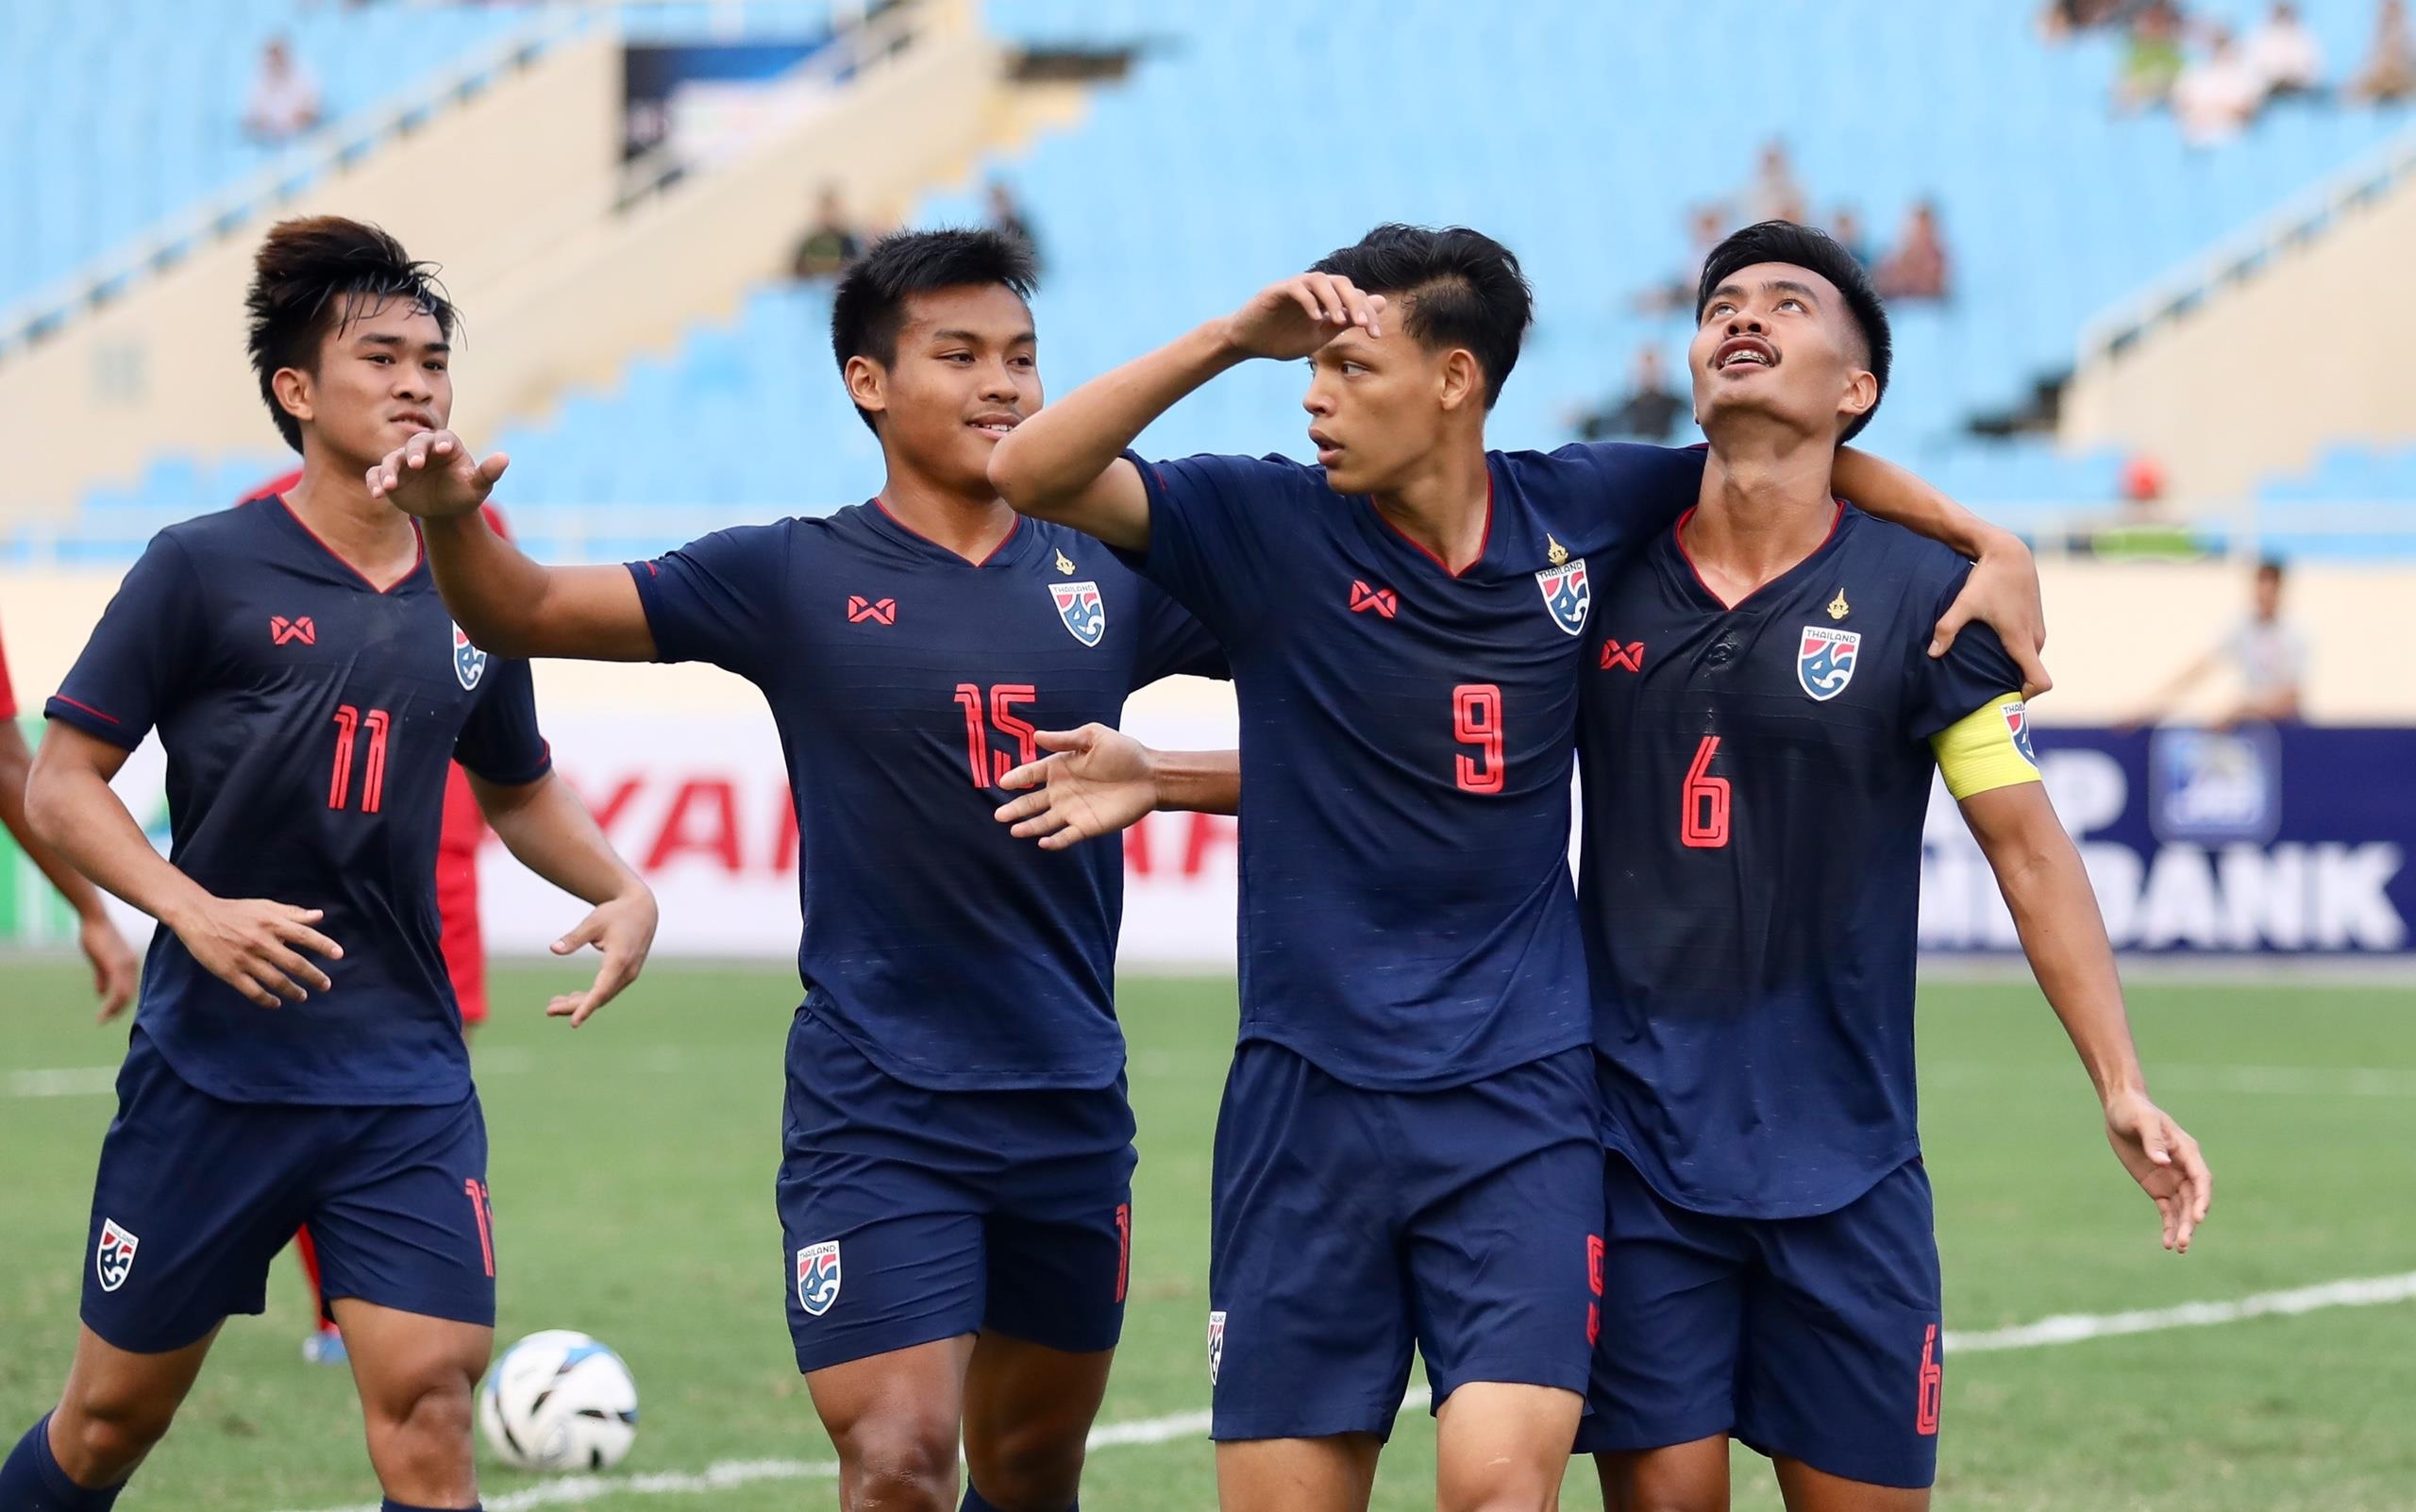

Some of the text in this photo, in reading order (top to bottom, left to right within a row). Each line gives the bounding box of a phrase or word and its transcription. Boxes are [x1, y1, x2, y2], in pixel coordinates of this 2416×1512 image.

[1052, 584, 1095, 594] THAILAND
[1538, 562, 1583, 580] THAILAND
[1806, 629, 1856, 644] THAILAND
[327, 704, 390, 813] 11
[953, 683, 1037, 789] 15
[1453, 683, 1504, 794] 9
[2002, 703, 2025, 714] THAIL
[1682, 735, 1730, 848] 6
[465, 1178, 495, 1277] 1
[1116, 1202, 1129, 1303] 1
[1916, 1323, 1941, 1436] 6
